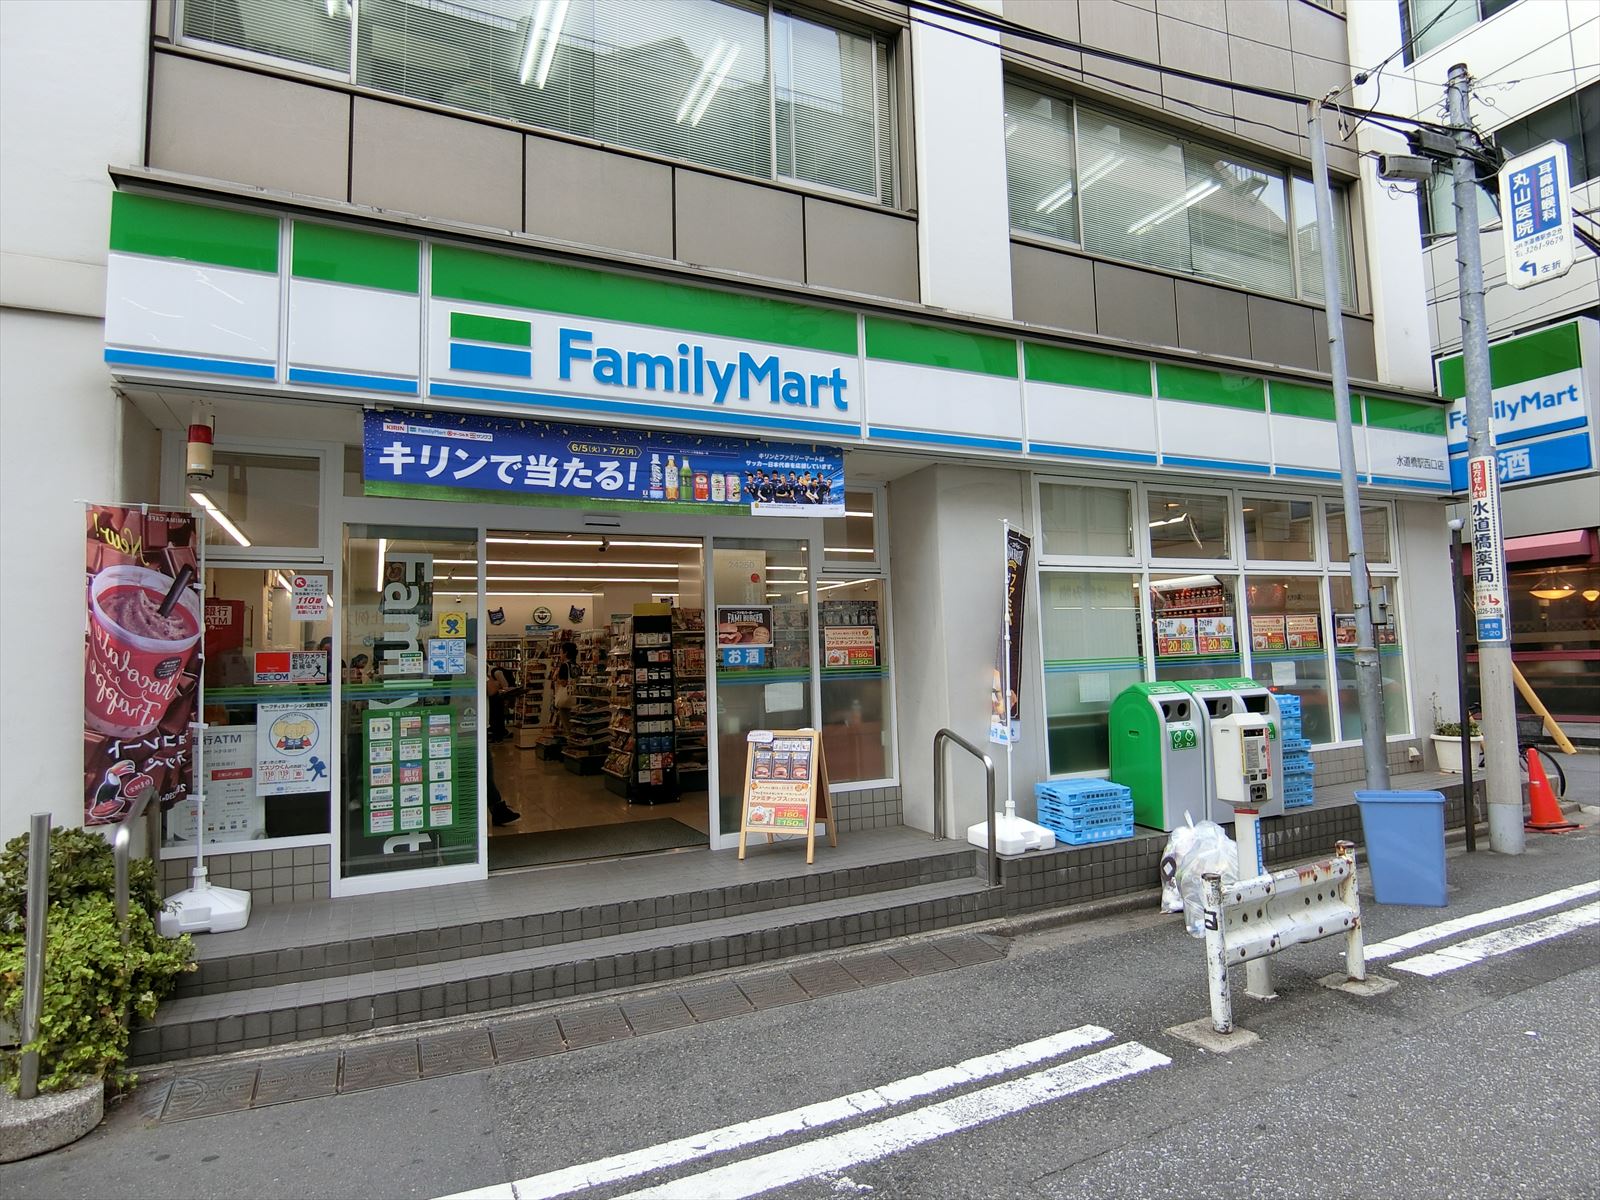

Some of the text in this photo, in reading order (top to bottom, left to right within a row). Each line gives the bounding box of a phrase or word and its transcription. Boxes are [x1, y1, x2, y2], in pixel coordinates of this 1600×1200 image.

[1538, 161, 1556, 222] 耳鼻咽喉科
[1513, 173, 1534, 238] 丸山医院
[1525, 235, 1564, 254] 3261-9679
[1541, 261, 1561, 273] 左折
[559, 327, 849, 411] FamilyMart
[1449, 384, 1578, 430] FilyMart
[417, 427, 447, 436] FamilyMart
[758, 452, 825, 463] キリンとファミリーマートは
[1396, 455, 1445, 470] 水道橋駅西口店
[1498, 448, 1531, 480] 酒
[1473, 500, 1494, 584] 水道橋薬局
[204, 616, 228, 625] ATM
[727, 613, 764, 624] FAMI BURGER
[728, 649, 760, 664] お酒
